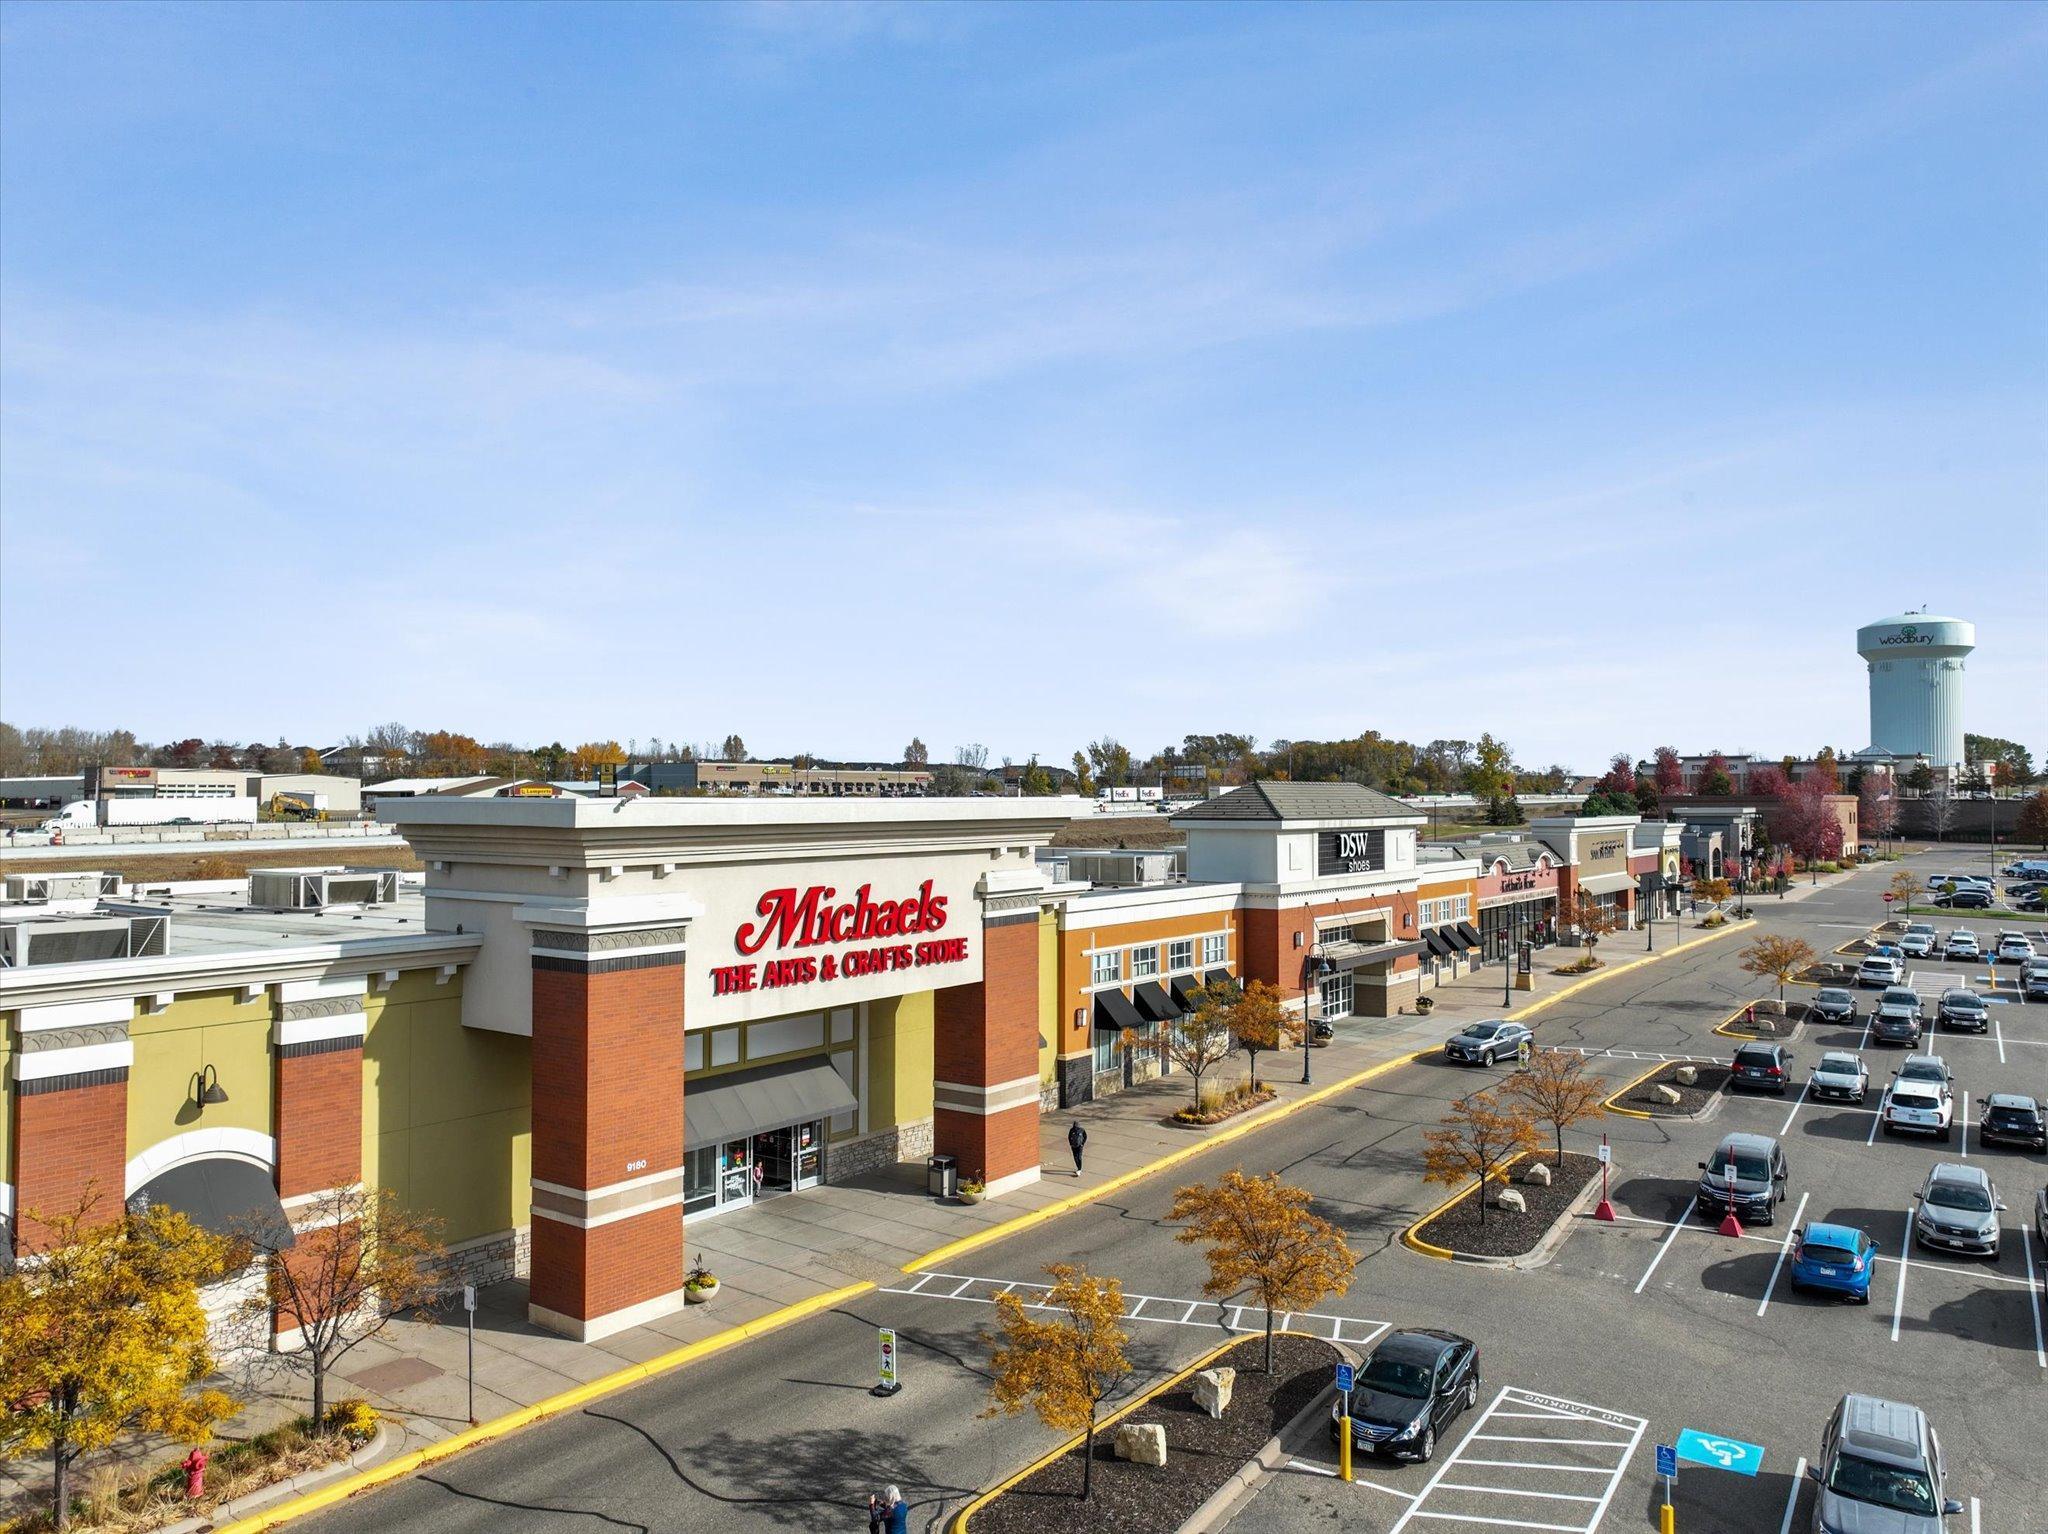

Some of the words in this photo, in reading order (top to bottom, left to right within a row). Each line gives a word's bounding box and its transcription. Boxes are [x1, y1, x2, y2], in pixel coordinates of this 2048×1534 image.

[1879, 633, 1935, 645] woodbury
[1340, 832, 1369, 857] DSW
[1348, 859, 1371, 873] shoes
[735, 879, 948, 956] Michaels
[710, 964, 758, 996] THE
[761, 957, 817, 989] ARTS
[820, 954, 839, 982] &
[841, 944, 913, 978] CRAFTS
[914, 937, 969, 967] STORE
[626, 1159, 647, 1172] 9180
[1525, 1394, 1590, 1415] PARKING
[1602, 1413, 1623, 1423] NO
